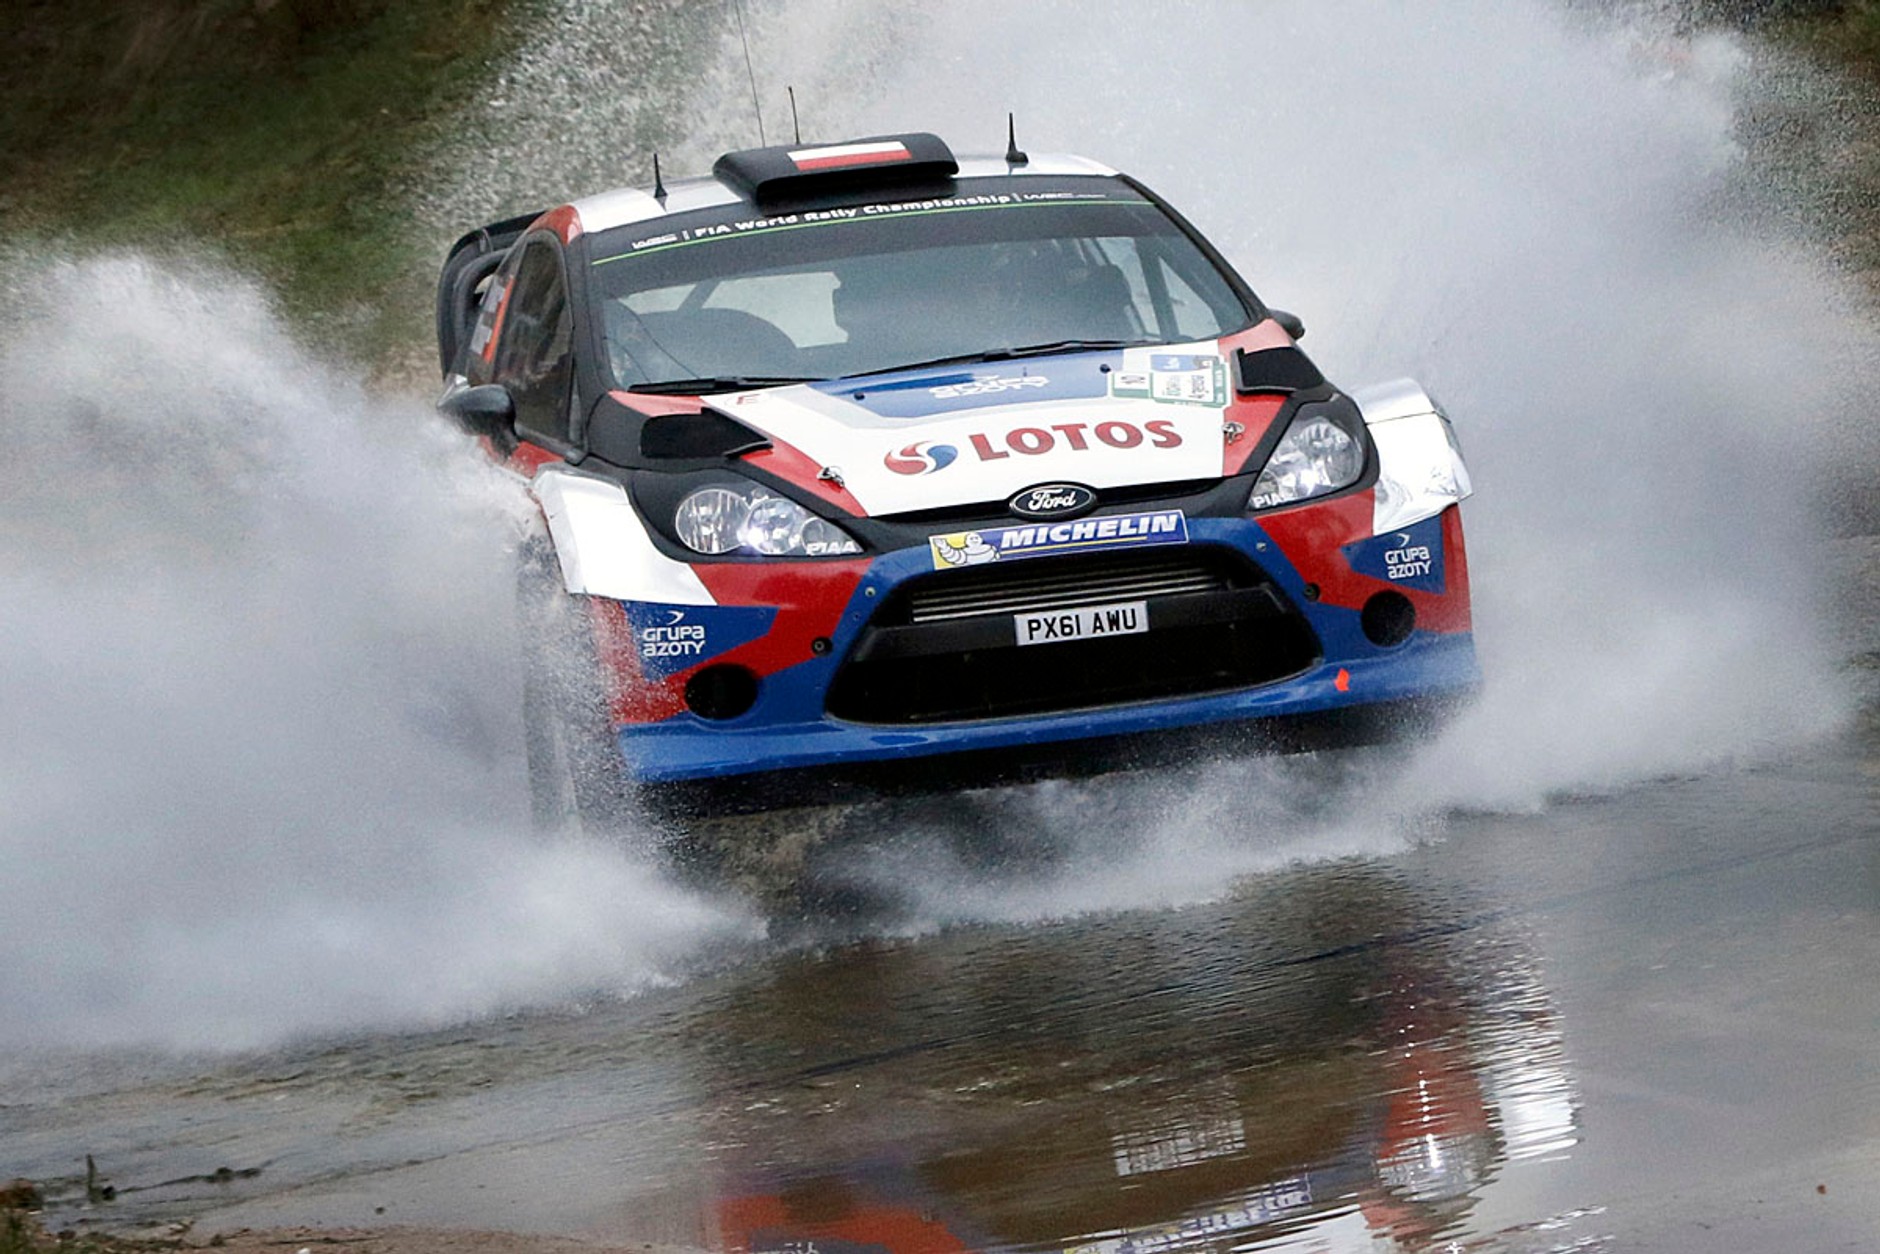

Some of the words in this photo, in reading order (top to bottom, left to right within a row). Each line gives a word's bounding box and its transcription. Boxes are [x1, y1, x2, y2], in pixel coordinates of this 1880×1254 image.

[694, 225, 731, 238] FIA
[735, 215, 798, 230] World
[804, 208, 857, 222] Rally
[863, 194, 1011, 214] Championship
[969, 420, 1183, 462] LOTOS
[1027, 488, 1077, 511] Ford
[1001, 514, 1179, 548] MICHELIN
[806, 540, 857, 556] PIAA
[1027, 614, 1081, 640] PX61
[1092, 609, 1137, 634] AWU
